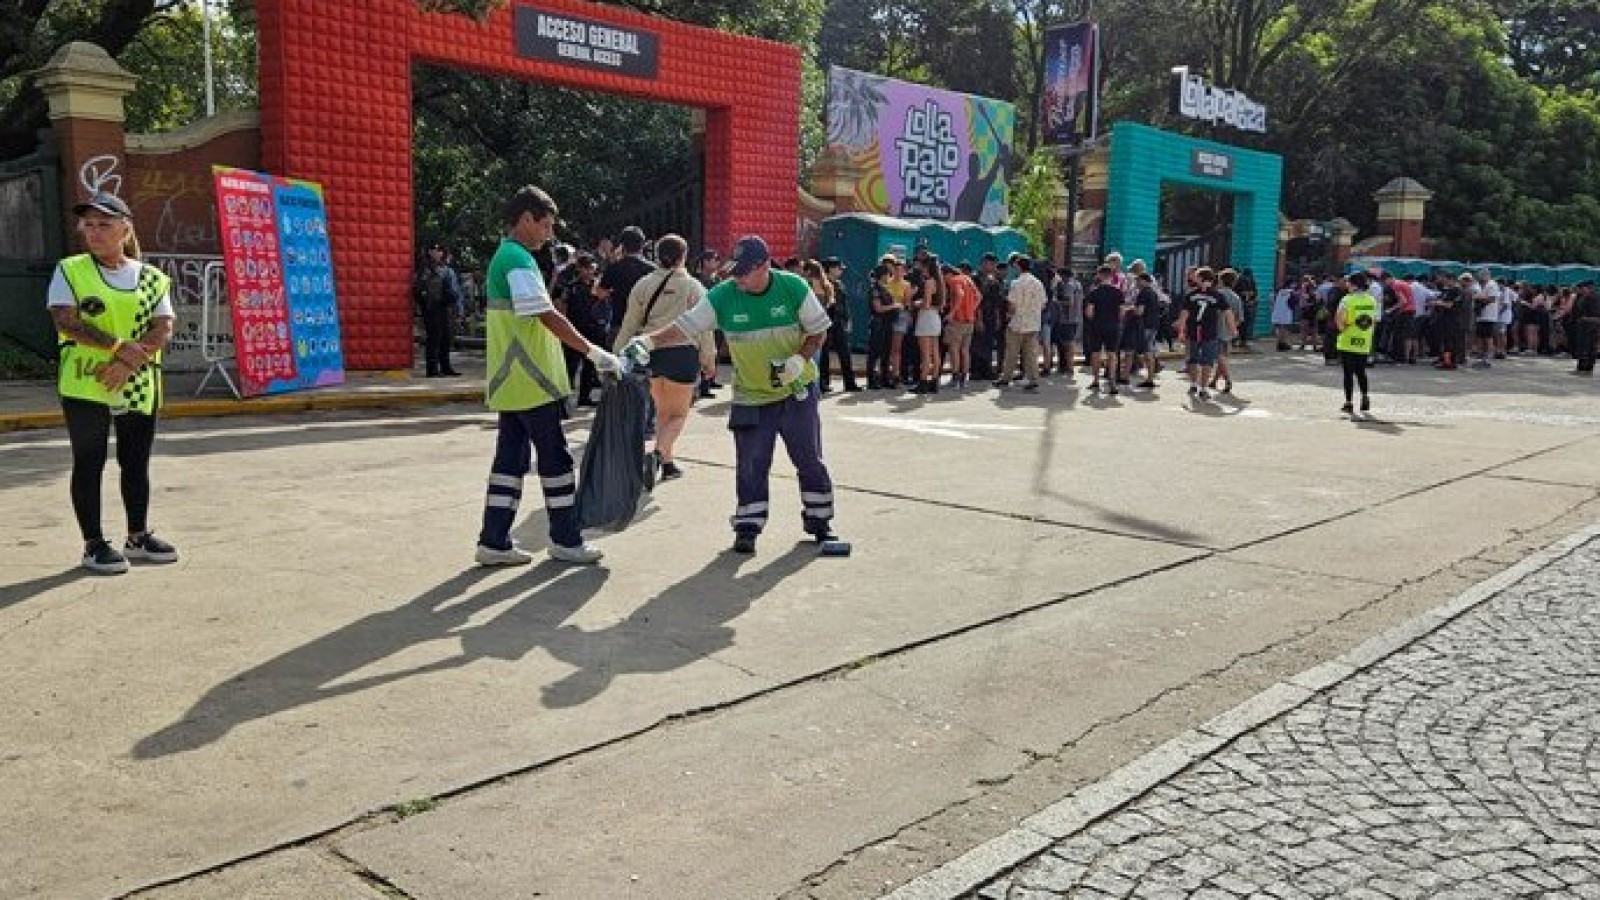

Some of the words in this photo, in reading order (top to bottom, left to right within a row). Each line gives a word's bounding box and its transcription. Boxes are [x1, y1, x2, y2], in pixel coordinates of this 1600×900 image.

[537, 14, 586, 43] ACCESO
[588, 25, 641, 54] GENERAL
[903, 202, 949, 215] ARGENTINA
